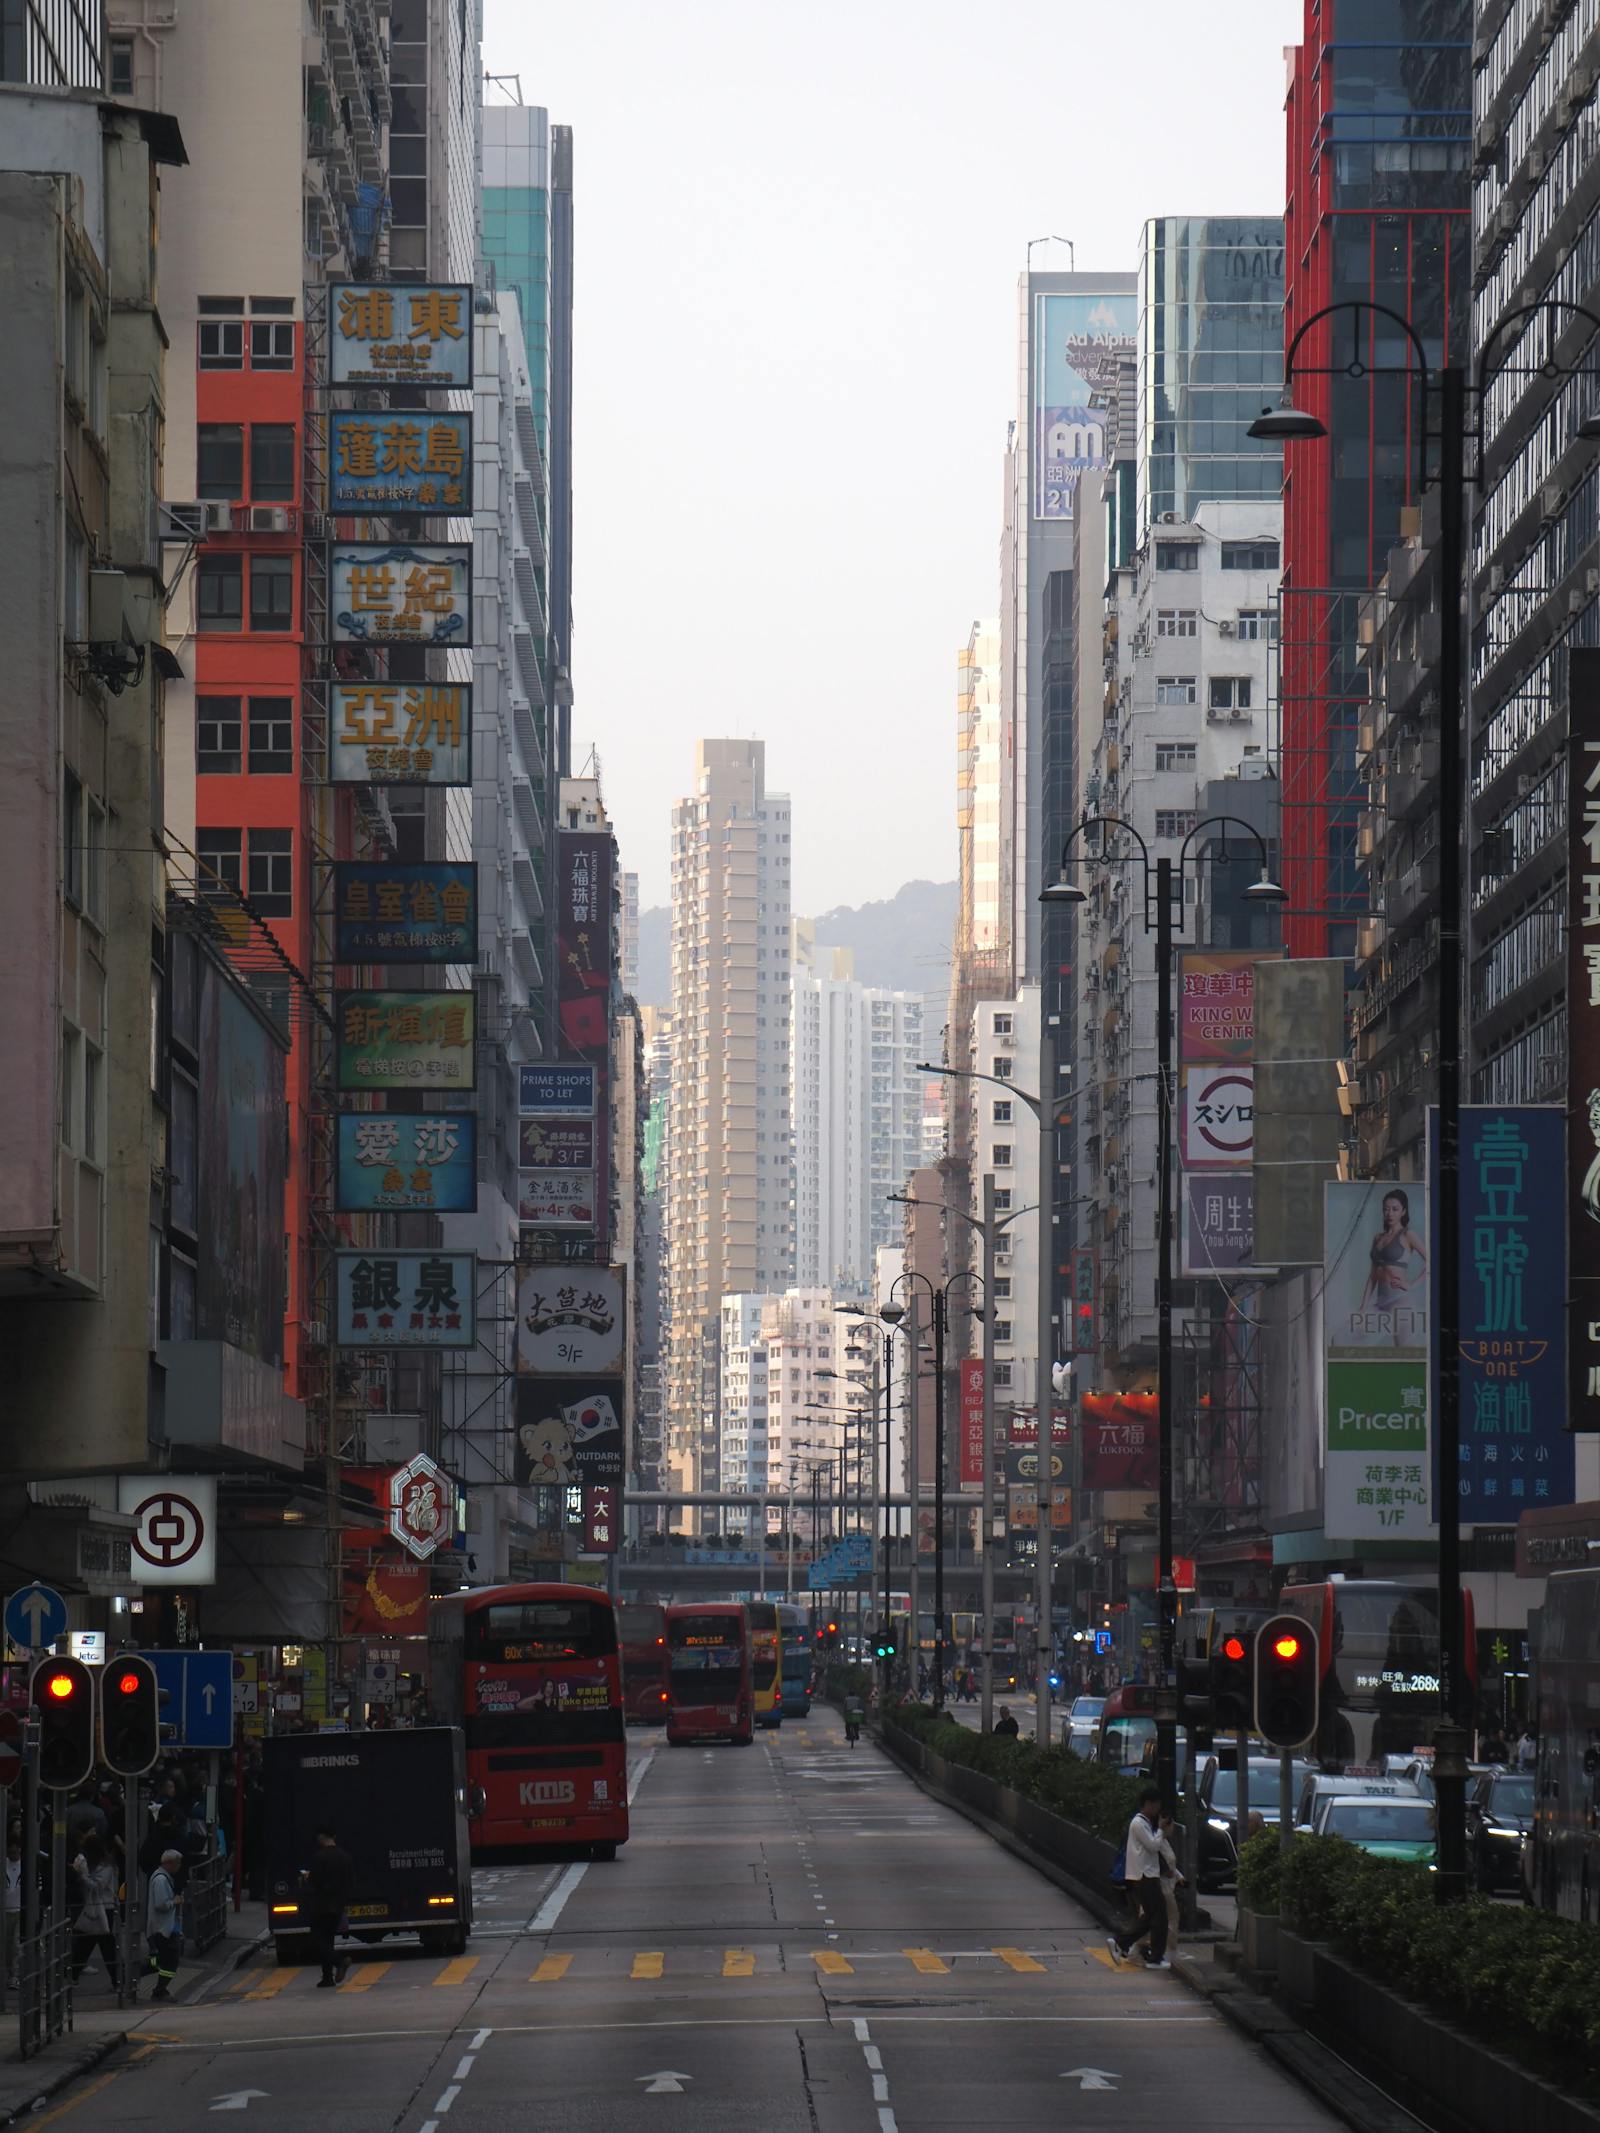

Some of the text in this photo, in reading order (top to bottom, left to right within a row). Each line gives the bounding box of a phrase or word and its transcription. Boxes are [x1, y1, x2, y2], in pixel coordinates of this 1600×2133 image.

[337, 289, 465, 342] 浦東
[1066, 332, 1087, 346] Ad
[337, 422, 465, 478] 蓬萊島
[346, 566, 455, 613] 世紀
[340, 686, 460, 747] 亞洲
[366, 747, 434, 770] 夜總會
[571, 850, 590, 923] 六福珠寶
[1184, 972, 1253, 997] 瓊華中
[1190, 1007, 1232, 1023] KING
[522, 1075, 591, 1086] PRIME SHOPS
[540, 1089, 573, 1099] TO LET
[1194, 1104, 1253, 1124] スシロ
[355, 1120, 459, 1167] 愛莎
[1473, 1116, 1529, 1332] 壹號
[350, 1258, 460, 1313] 銀泉
[558, 1343, 583, 1363] 3/F
[1479, 1340, 1525, 1356] BOAT
[1473, 1381, 1531, 1433] 漁船
[1098, 1421, 1145, 1445] 六福
[576, 1452, 621, 1461] OUTDARK
[1099, 1446, 1145, 1455] LUKFOOK
[1366, 1465, 1422, 1482] 荷李活
[1356, 1488, 1427, 1505] 商業中心
[405, 1482, 440, 1532] 福
[1378, 1509, 1405, 1526] 1/F
[242, 1701, 255, 1712] 12
[311, 1755, 360, 1768] BRINKS
[520, 1780, 576, 1807] KMB
[1364, 1786, 1395, 1794] TAXI
[423, 1847, 444, 1857] Hotline
